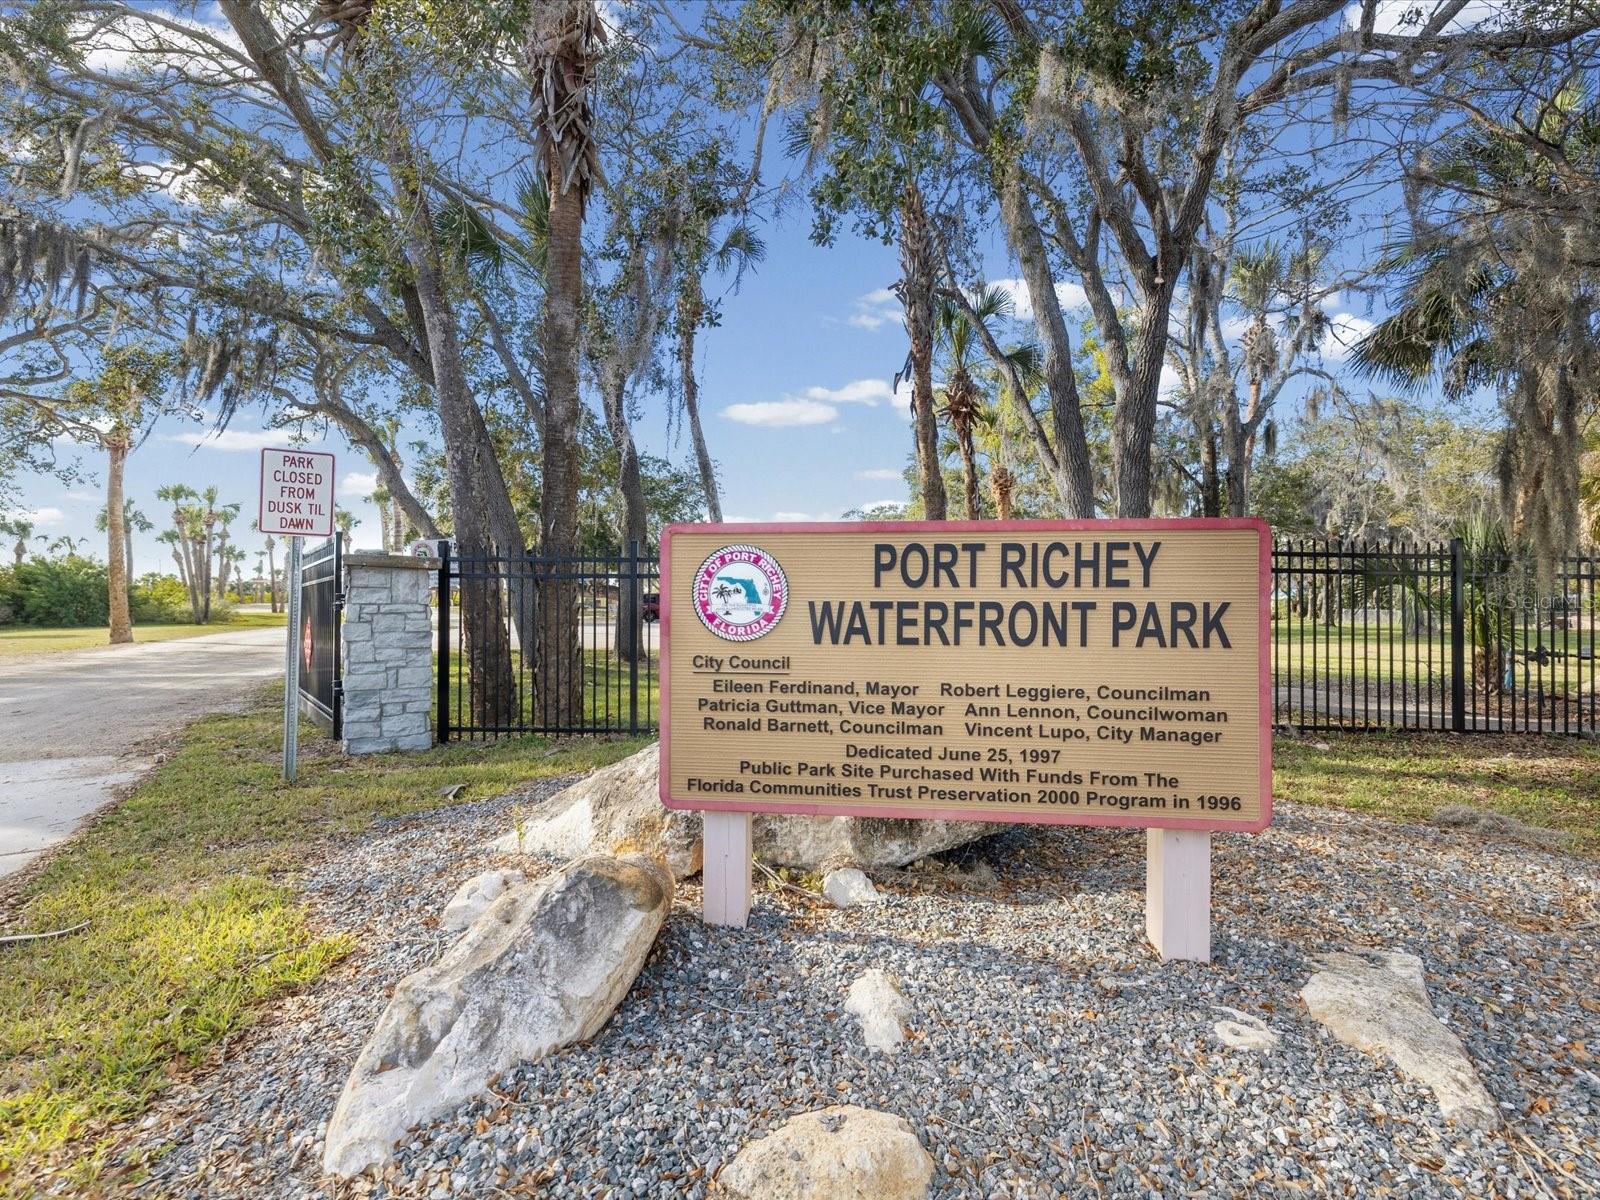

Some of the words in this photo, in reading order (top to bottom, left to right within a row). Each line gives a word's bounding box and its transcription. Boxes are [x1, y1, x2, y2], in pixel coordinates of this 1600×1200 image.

[282, 455, 314, 468] PARK
[273, 470, 323, 485] CLOSED
[280, 486, 315, 500] FROM
[268, 500, 302, 514] DUSK
[308, 503, 325, 516] TIL
[279, 516, 314, 530] DAWN
[874, 542, 985, 588] PORT
[1000, 541, 1162, 588] RICHEY
[699, 574, 710, 600] CITY
[708, 558, 721, 573] OF
[724, 552, 757, 563] PORT
[757, 559, 782, 599] RICHEY
[712, 618, 769, 636] FLORIDA
[808, 600, 1097, 647] WATERFRONT
[1112, 601, 1232, 649] PARK
[692, 655, 723, 671] City
[729, 656, 790, 670] Council
[713, 680, 763, 694] Eileen
[769, 680, 860, 697] Ferdinand,
[865, 682, 919, 699] Mayor
[940, 683, 1000, 698] Robert
[1006, 684, 1090, 702] Leggiere,
[1097, 685, 1210, 702] Councilman
[698, 698, 760, 712] Patricia
[766, 699, 843, 716] Guttman,
[849, 701, 885, 715] Vice
[891, 702, 945, 719] Mayor
[965, 703, 1000, 718] Ann
[1007, 703, 1080, 721] Lennon,
[1087, 705, 1228, 723] Councilwoman
[703, 717, 761, 731] Ronald
[767, 718, 833, 735] Barnett,
[839, 720, 943, 736] Councilman
[965, 722, 1033, 738] Vincent
[1039, 724, 1090, 742] Lupo,
[1097, 725, 1133, 744] City
[1140, 726, 1222, 746] Manager
[846, 744, 932, 760] Dedicated
[938, 747, 981, 762] June
[987, 748, 1012, 765] 25,
[1019, 749, 1061, 764] 1997
[740, 761, 791, 776] Public
[797, 762, 835, 777] Park
[841, 764, 874, 778] Site
[880, 765, 973, 782] Purchased
[979, 768, 1020, 783] With
[1026, 769, 1083, 785] Funds
[1090, 771, 1138, 787] From
[1144, 772, 1179, 789] The
[687, 779, 744, 793] Florida
[749, 780, 862, 797] Communities
[867, 784, 912, 799] Trust
[918, 786, 1031, 804] Preservation
[1037, 789, 1080, 805] 2000
[1086, 791, 1166, 810] Program
[1173, 794, 1189, 809] in
[1197, 794, 1242, 811] 1996
